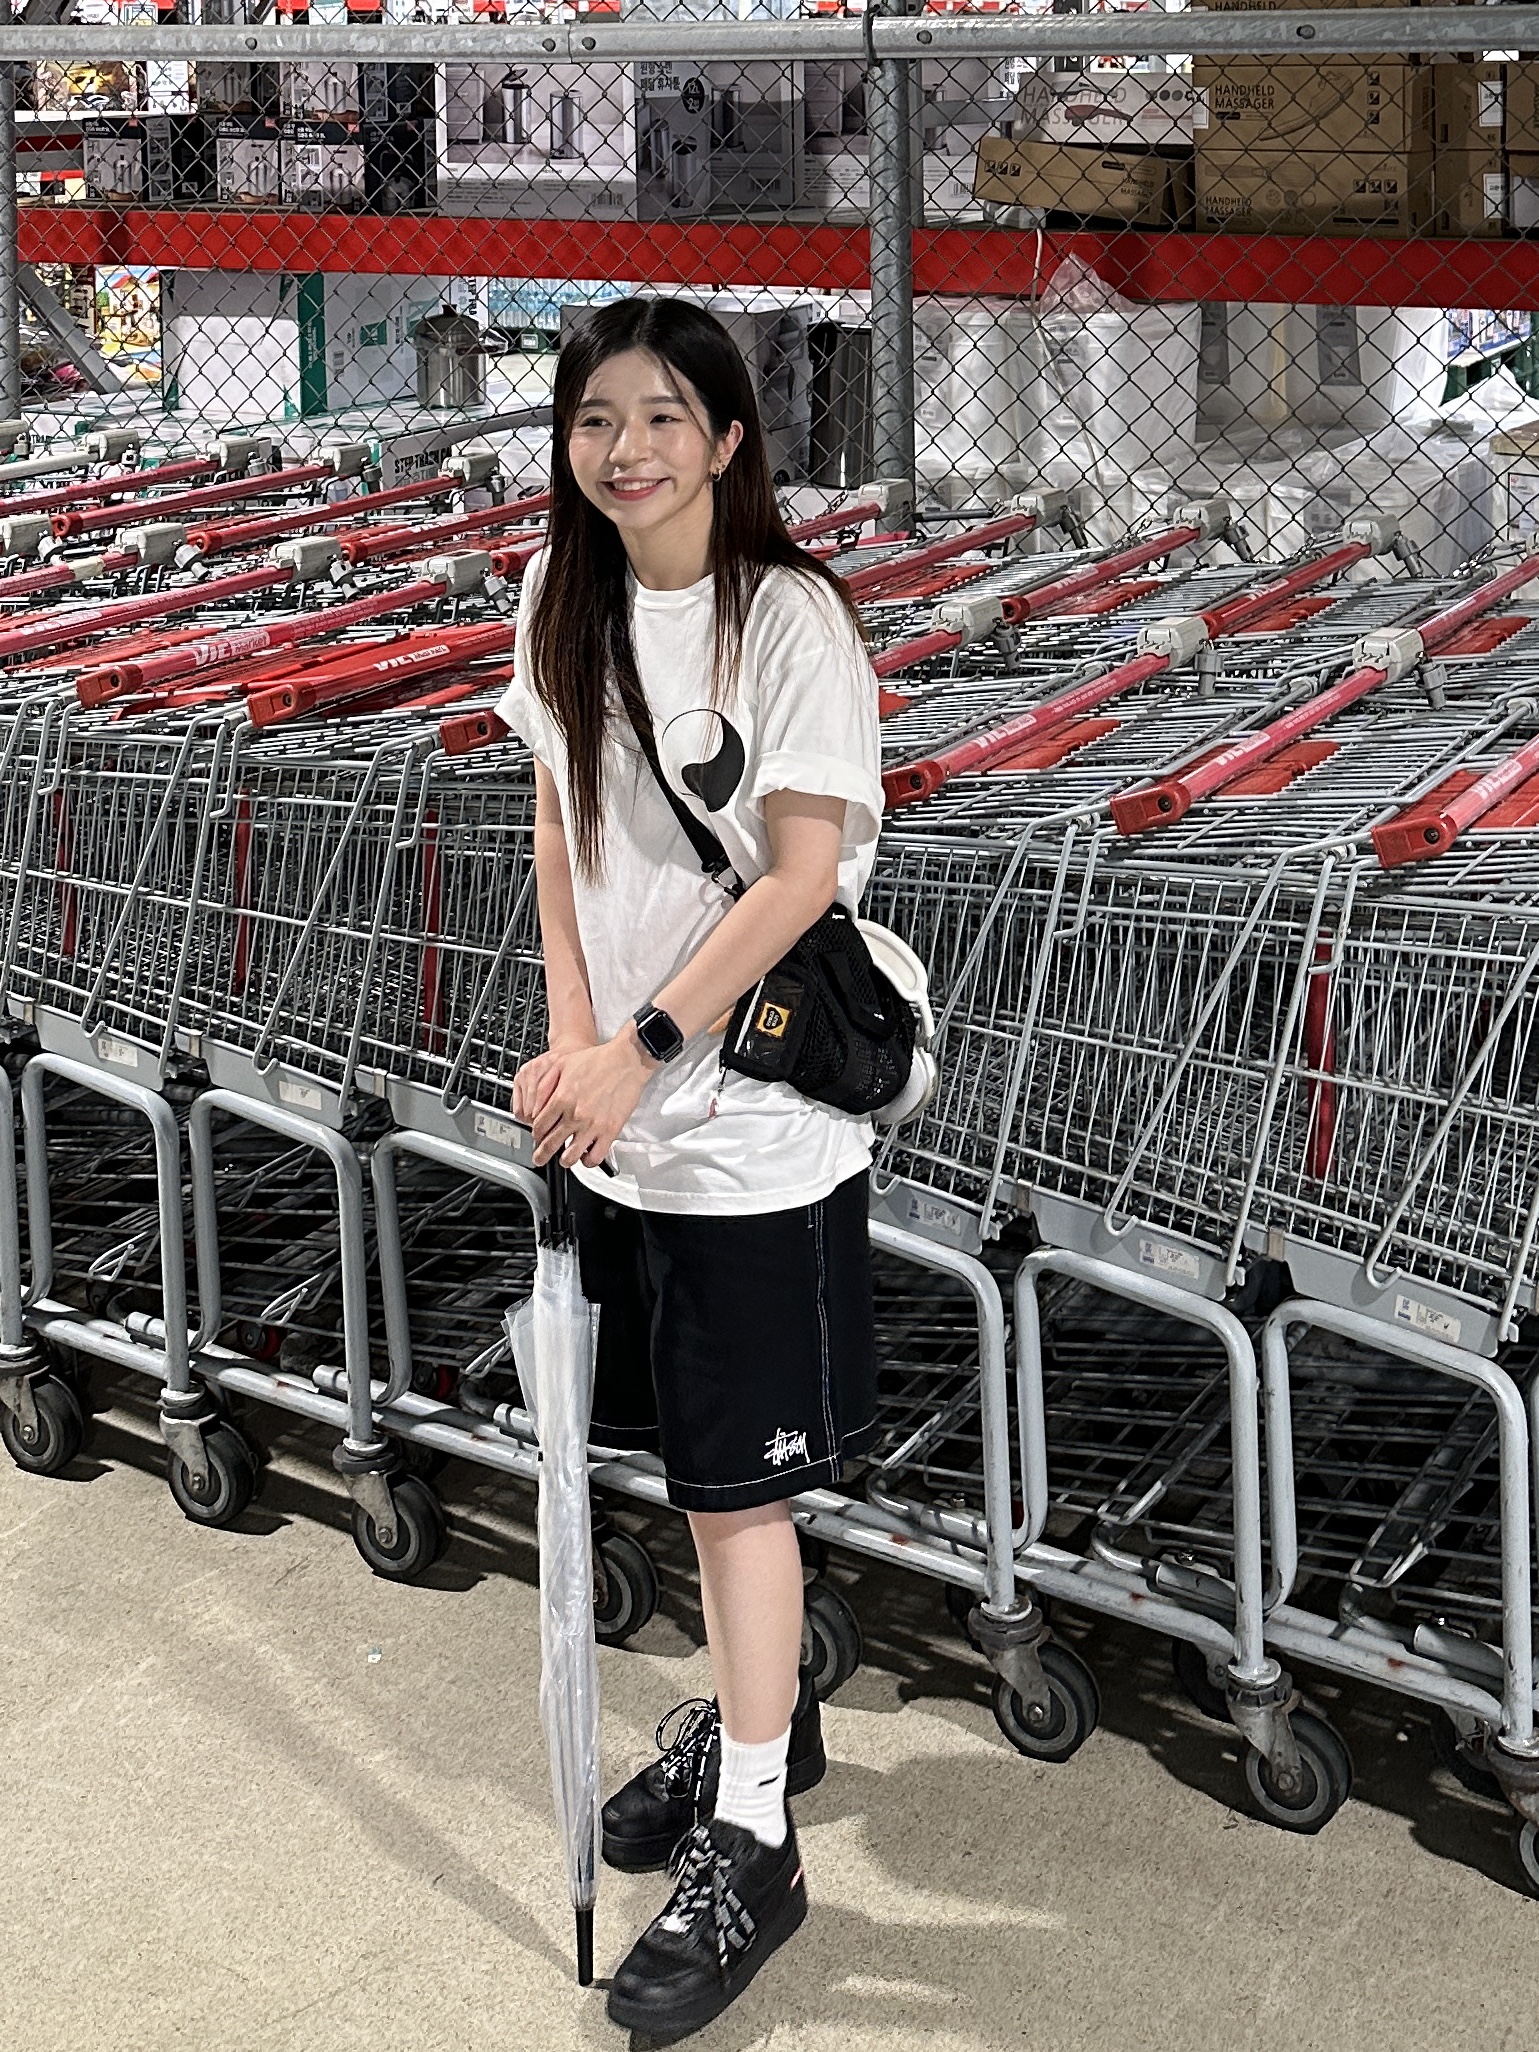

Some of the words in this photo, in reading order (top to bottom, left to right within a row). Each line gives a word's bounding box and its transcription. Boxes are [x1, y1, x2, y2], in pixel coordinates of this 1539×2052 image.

[1214, 1, 1277, 12] HANDHELD
[1024, 86, 1127, 103] HADHED
[1214, 84, 1275, 96] HANDHELD
[1214, 97, 1275, 110] MASSAGER
[1020, 107, 1124, 125] MASSGER
[192, 642, 231, 666] VIC
[373, 655, 412, 671] VIC
